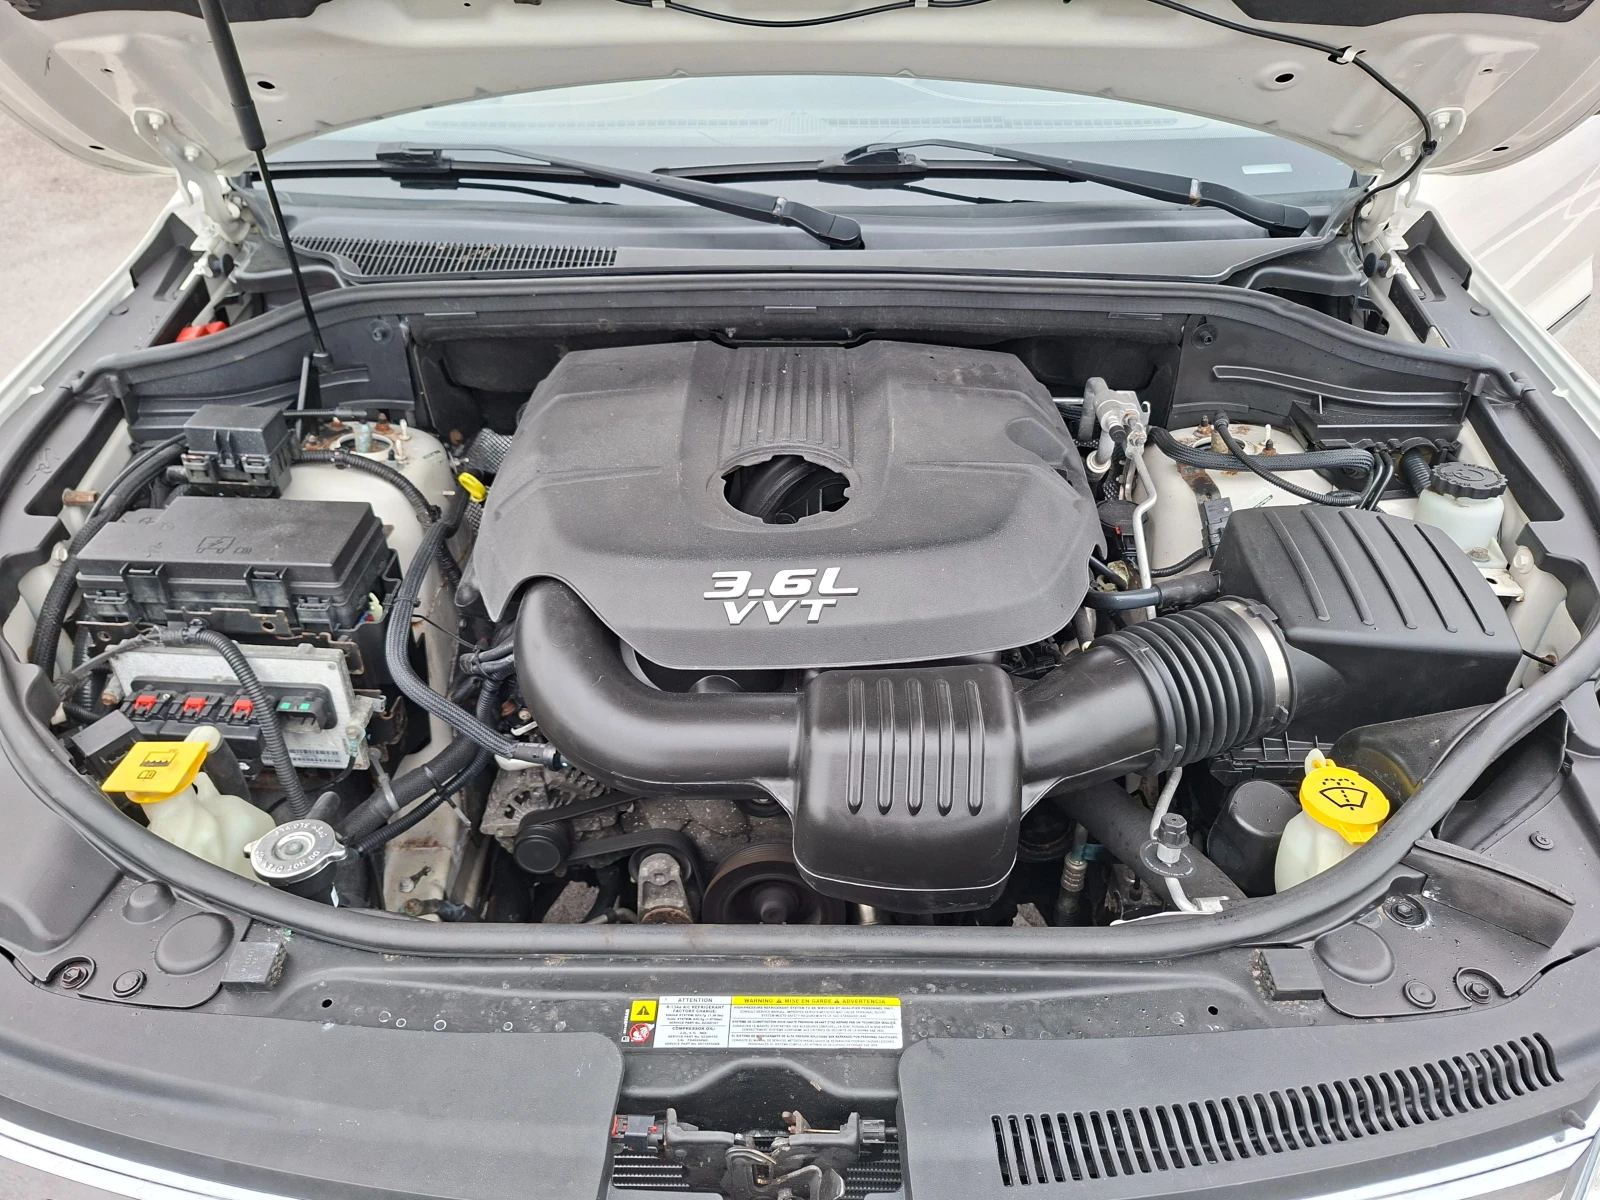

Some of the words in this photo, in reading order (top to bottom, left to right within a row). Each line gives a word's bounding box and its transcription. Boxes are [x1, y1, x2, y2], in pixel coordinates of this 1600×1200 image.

[703, 567, 860, 600] 3.6L
[723, 599, 838, 626] VVT
[308, 850, 320, 861] DO
[288, 860, 307, 871] NOT
